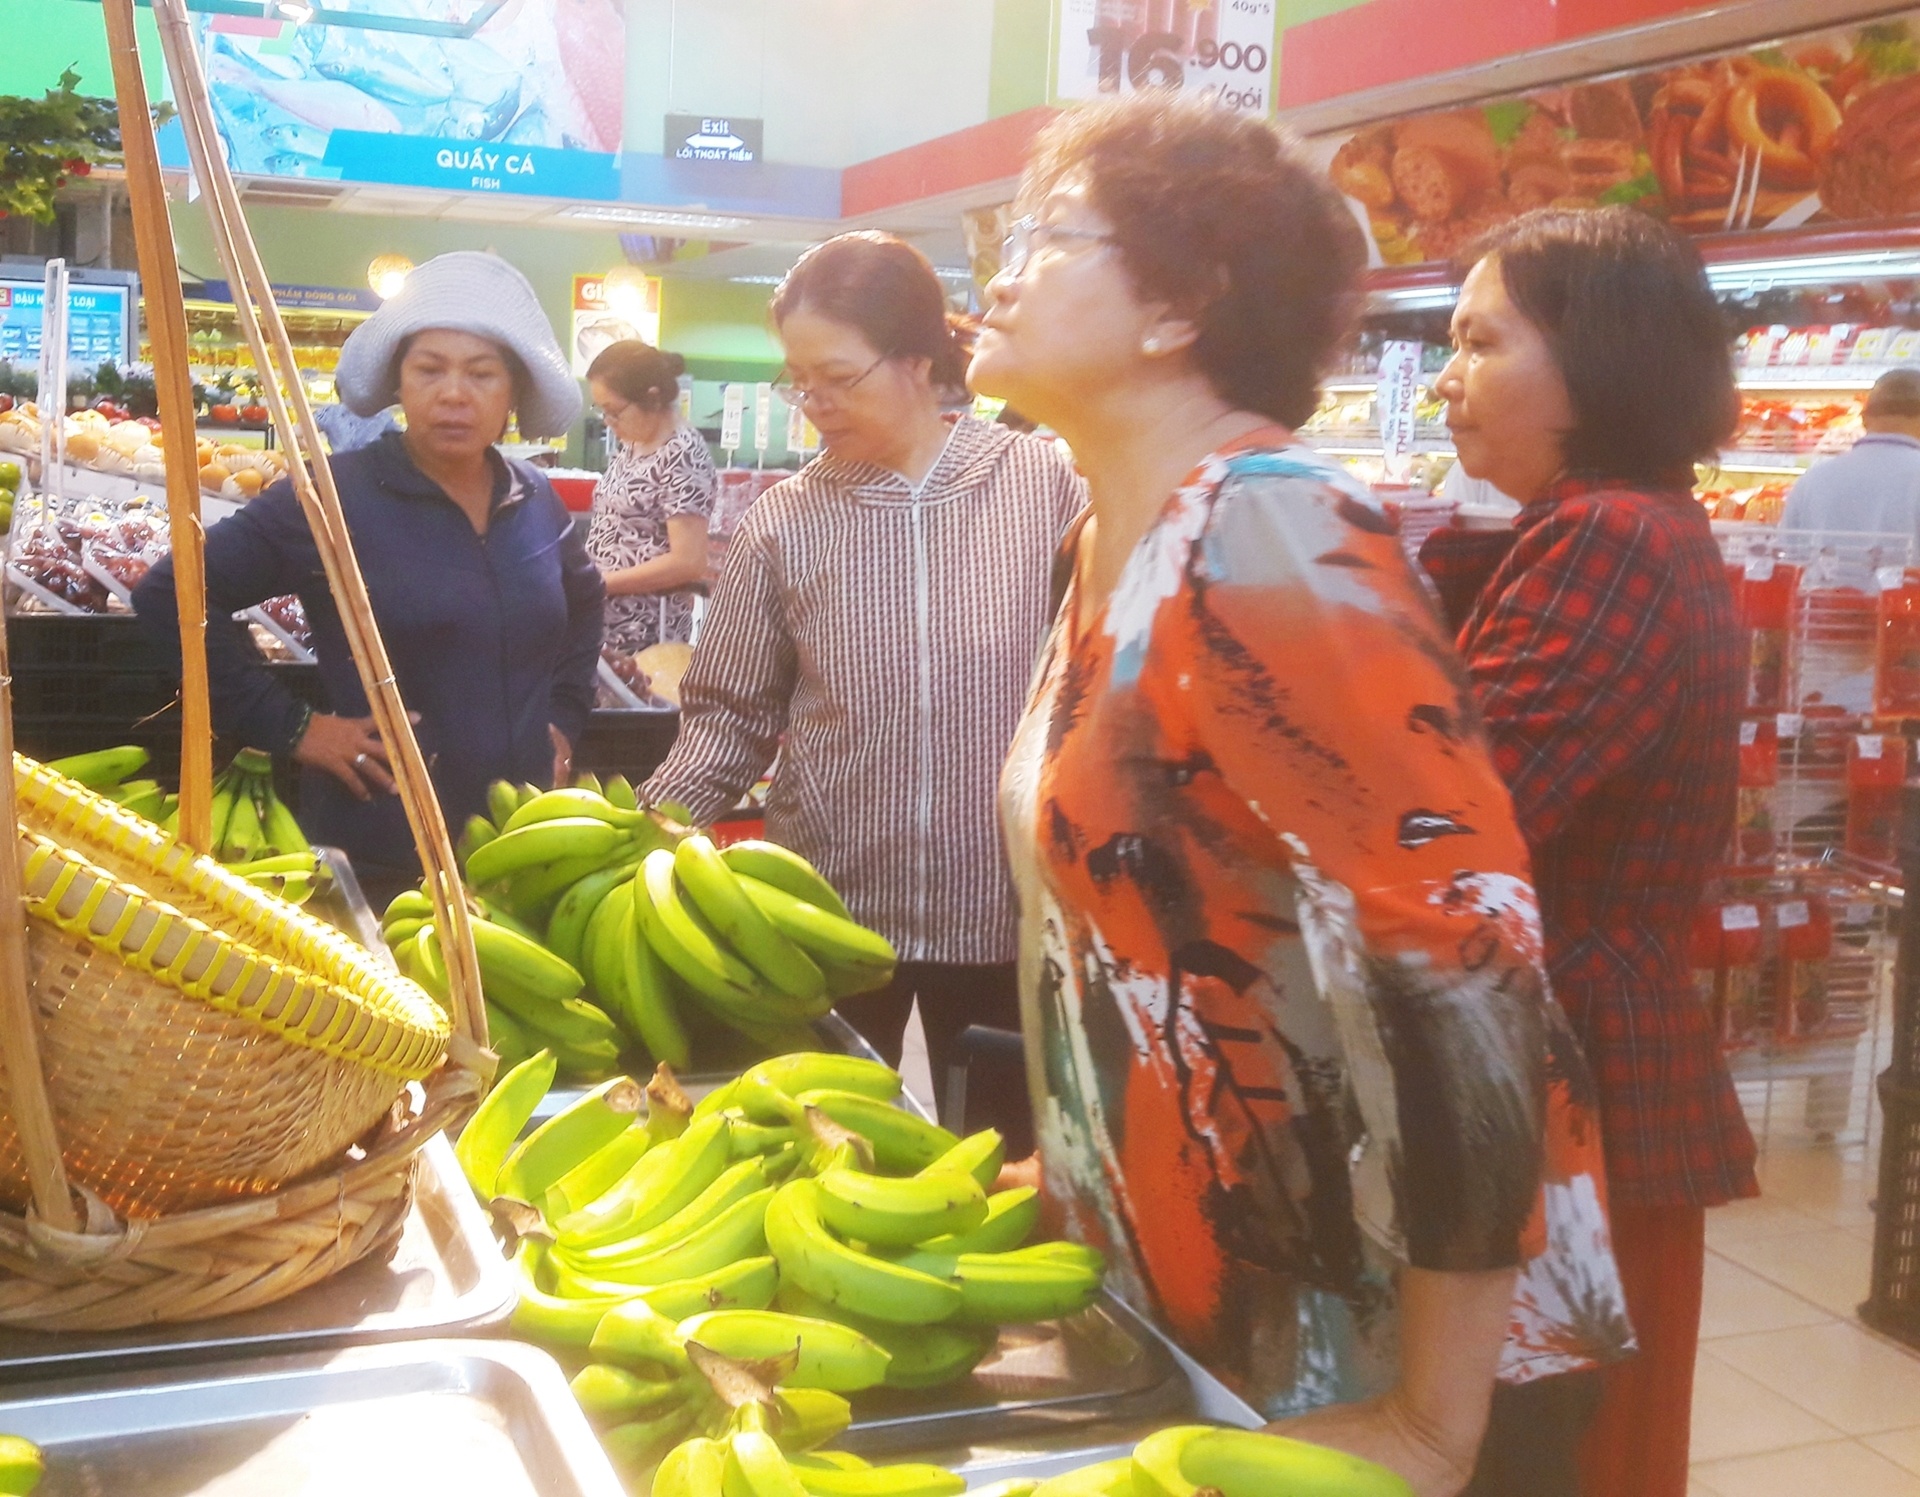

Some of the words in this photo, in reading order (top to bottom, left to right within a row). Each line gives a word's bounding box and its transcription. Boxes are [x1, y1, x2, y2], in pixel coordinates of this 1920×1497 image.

[701, 119, 730, 135] Exit
[504, 152, 536, 176] CÁ
[471, 176, 500, 190] FISH
